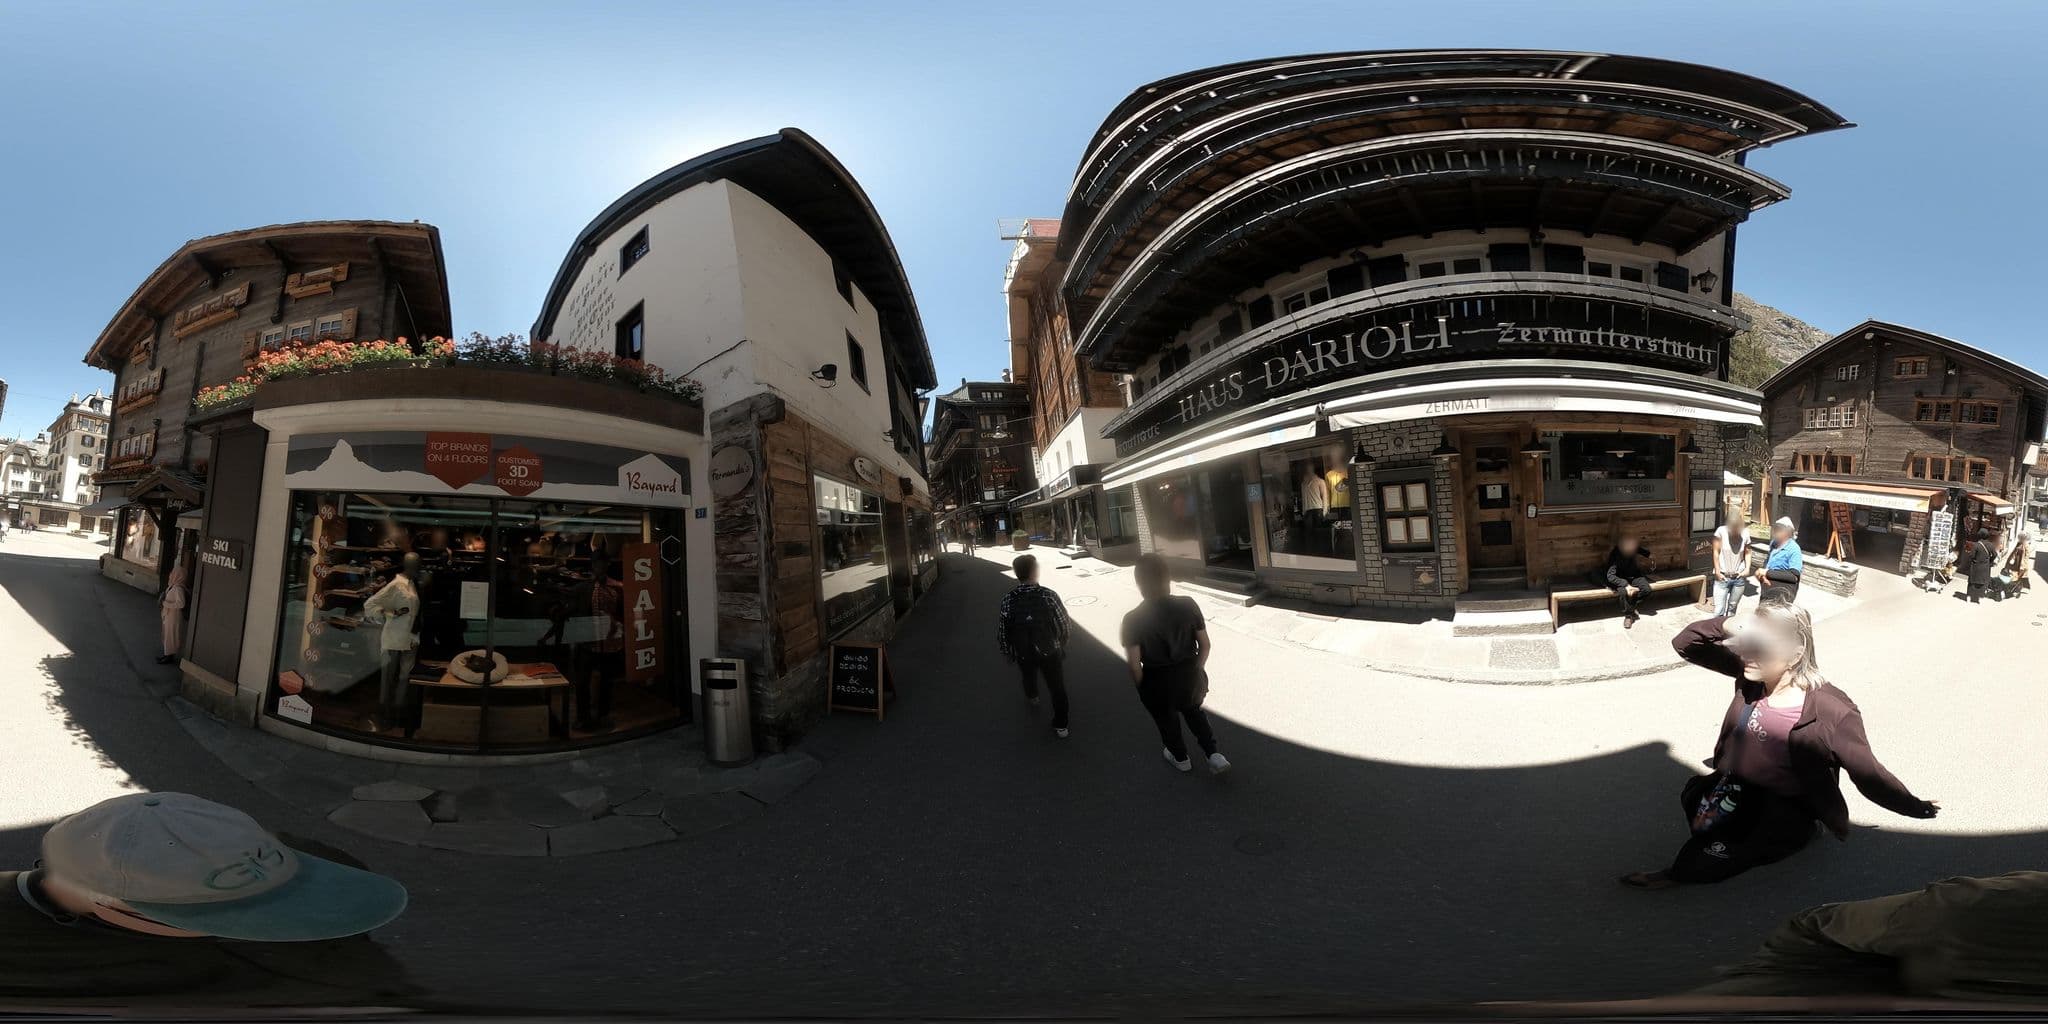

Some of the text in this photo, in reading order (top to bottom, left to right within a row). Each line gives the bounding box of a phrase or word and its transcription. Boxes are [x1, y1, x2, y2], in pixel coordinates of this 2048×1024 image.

[1179, 371, 1243, 423] HAUS
[1264, 315, 1452, 389] DARIOLI
[1425, 398, 1488, 414] ZERMATT
[430, 442, 488, 453] TOP BRANDS
[427, 453, 488, 464] ON 4 FLOORS
[498, 456, 540, 466] CUSTOMIZE
[509, 465, 528, 478] 3D
[497, 478, 540, 488] FOOT SCAN
[626, 471, 677, 499] Bayard
[212, 539, 229, 552] SKI
[202, 552, 237, 569] RENTAL
[633, 558, 656, 670] SALE
